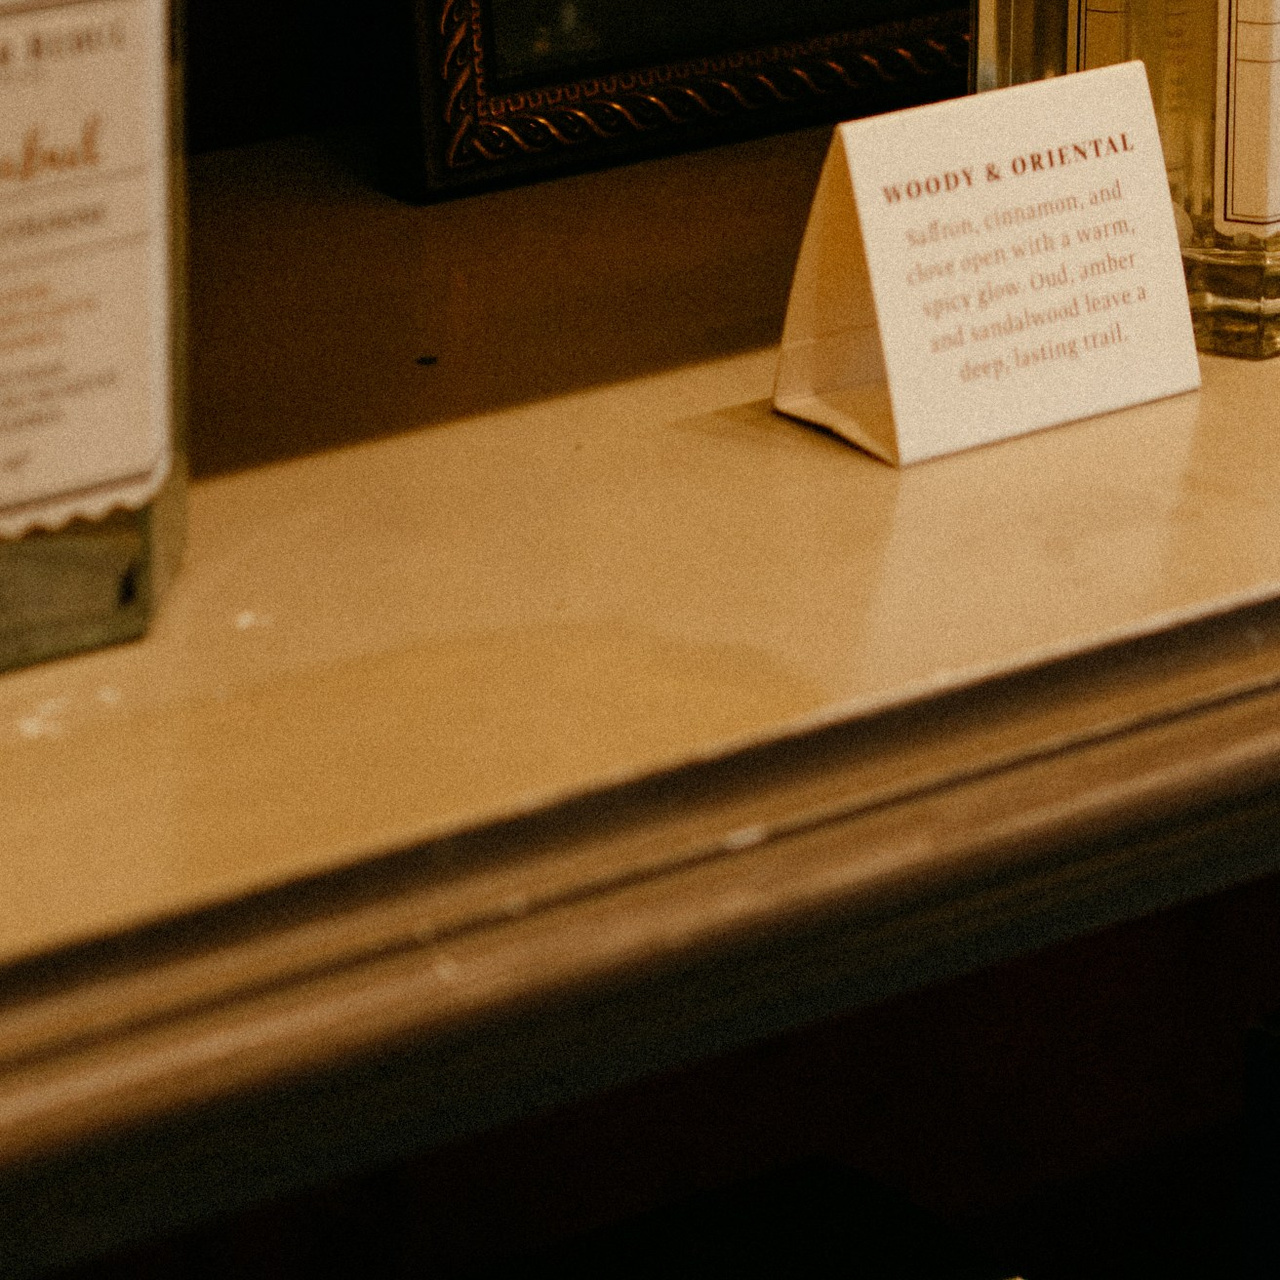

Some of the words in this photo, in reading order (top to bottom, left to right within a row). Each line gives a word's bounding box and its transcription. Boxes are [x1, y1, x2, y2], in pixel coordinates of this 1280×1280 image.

[882, 166, 974, 205] WOODY
[985, 162, 1001, 183] &
[1011, 132, 1135, 177] ORIENTAL
[983, 194, 1085, 231] cinnamon,
[1088, 178, 1123, 206] and
[960, 247, 1007, 275] open
[1011, 232, 1059, 259] with
[1061, 234, 1071, 248] a
[1076, 218, 1137, 243] warm,
[922, 293, 973, 322] spicy
[1078, 251, 1137, 281] amber
[930, 327, 966, 355] and
[971, 298, 1081, 338] sandalwood
[1084, 290, 1132, 313] leave
[1136, 286, 1147, 301] a
[1013, 334, 1078, 370] lasting
